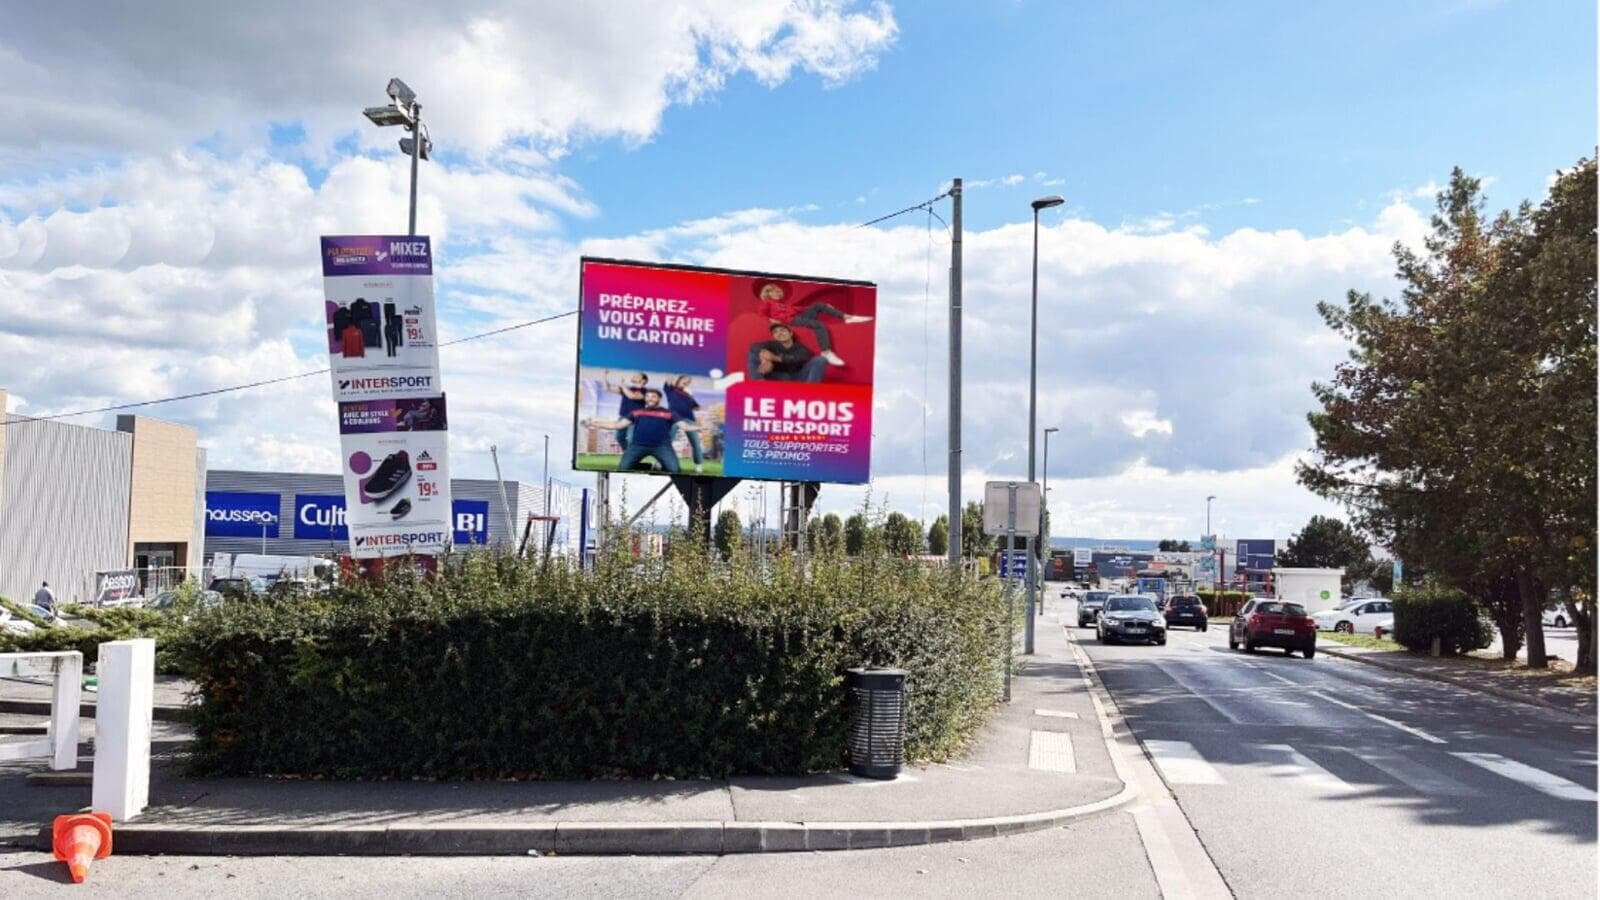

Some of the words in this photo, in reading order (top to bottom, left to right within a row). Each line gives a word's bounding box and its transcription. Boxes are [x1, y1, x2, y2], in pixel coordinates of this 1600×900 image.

[390, 242, 427, 256] MIXEZ
[599, 293, 696, 314] PRÉPAREZ-
[599, 310, 645, 326] VOUS
[649, 312, 661, 327] À
[665, 315, 715, 332] FAIRE
[598, 325, 622, 340] UN
[627, 328, 694, 346] CARTON
[698, 334, 705, 347] !
[351, 376, 433, 389] INTERSPORT
[744, 397, 776, 418] LE
[783, 399, 855, 422] MOIS
[743, 419, 852, 436] INTERSPORT
[743, 439, 770, 449] TOUS
[742, 449, 764, 458] DES
[765, 450, 812, 461] PROMOS
[417, 482, 431, 496] 19
[366, 532, 443, 546] INTERSPORT
